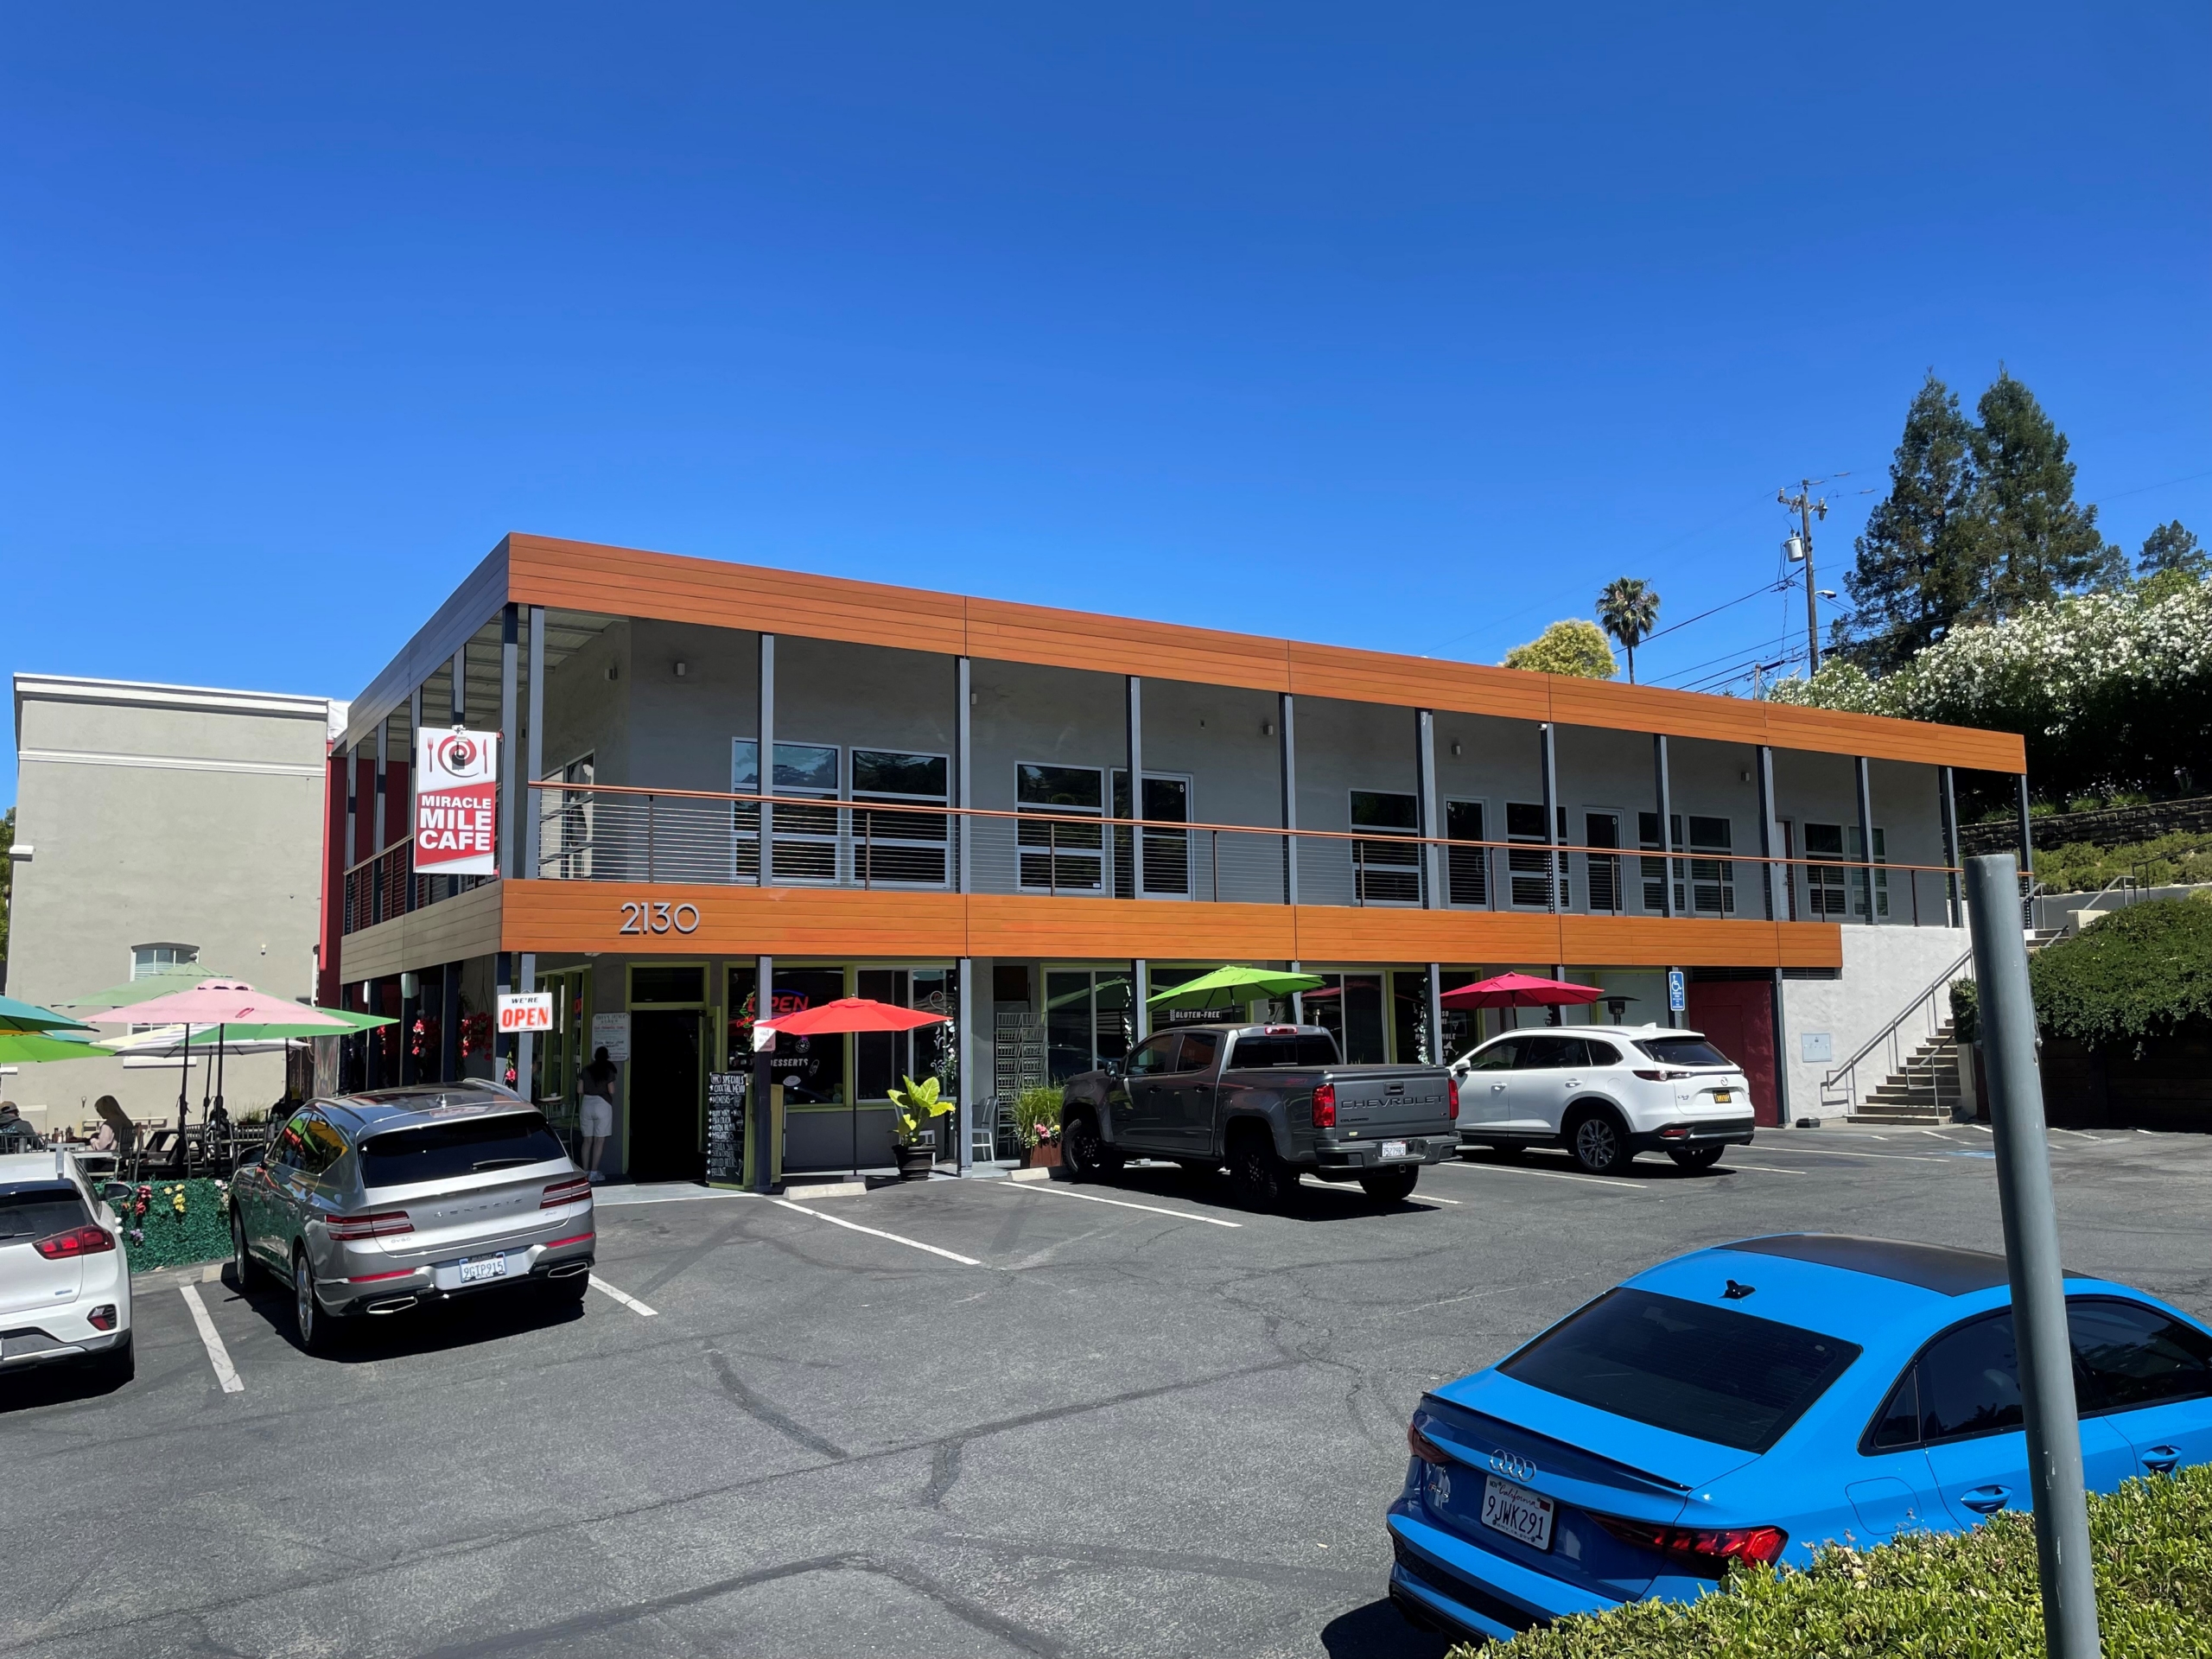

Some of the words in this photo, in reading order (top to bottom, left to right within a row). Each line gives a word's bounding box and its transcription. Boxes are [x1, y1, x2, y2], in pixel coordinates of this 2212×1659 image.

[1179, 784, 1185, 792] B
[421, 795, 492, 809] MIRACLE
[420, 808, 492, 831] MILE
[419, 830, 491, 851] CAFE
[620, 902, 700, 934] 2130
[502, 1007, 550, 1027] OPEN
[1341, 1095, 1445, 1109] CHEVROLET
[464, 1261, 503, 1279] 9GIP915
[1499, 1484, 1540, 1510] California
[1486, 1495, 1544, 1541] 9JWK291
